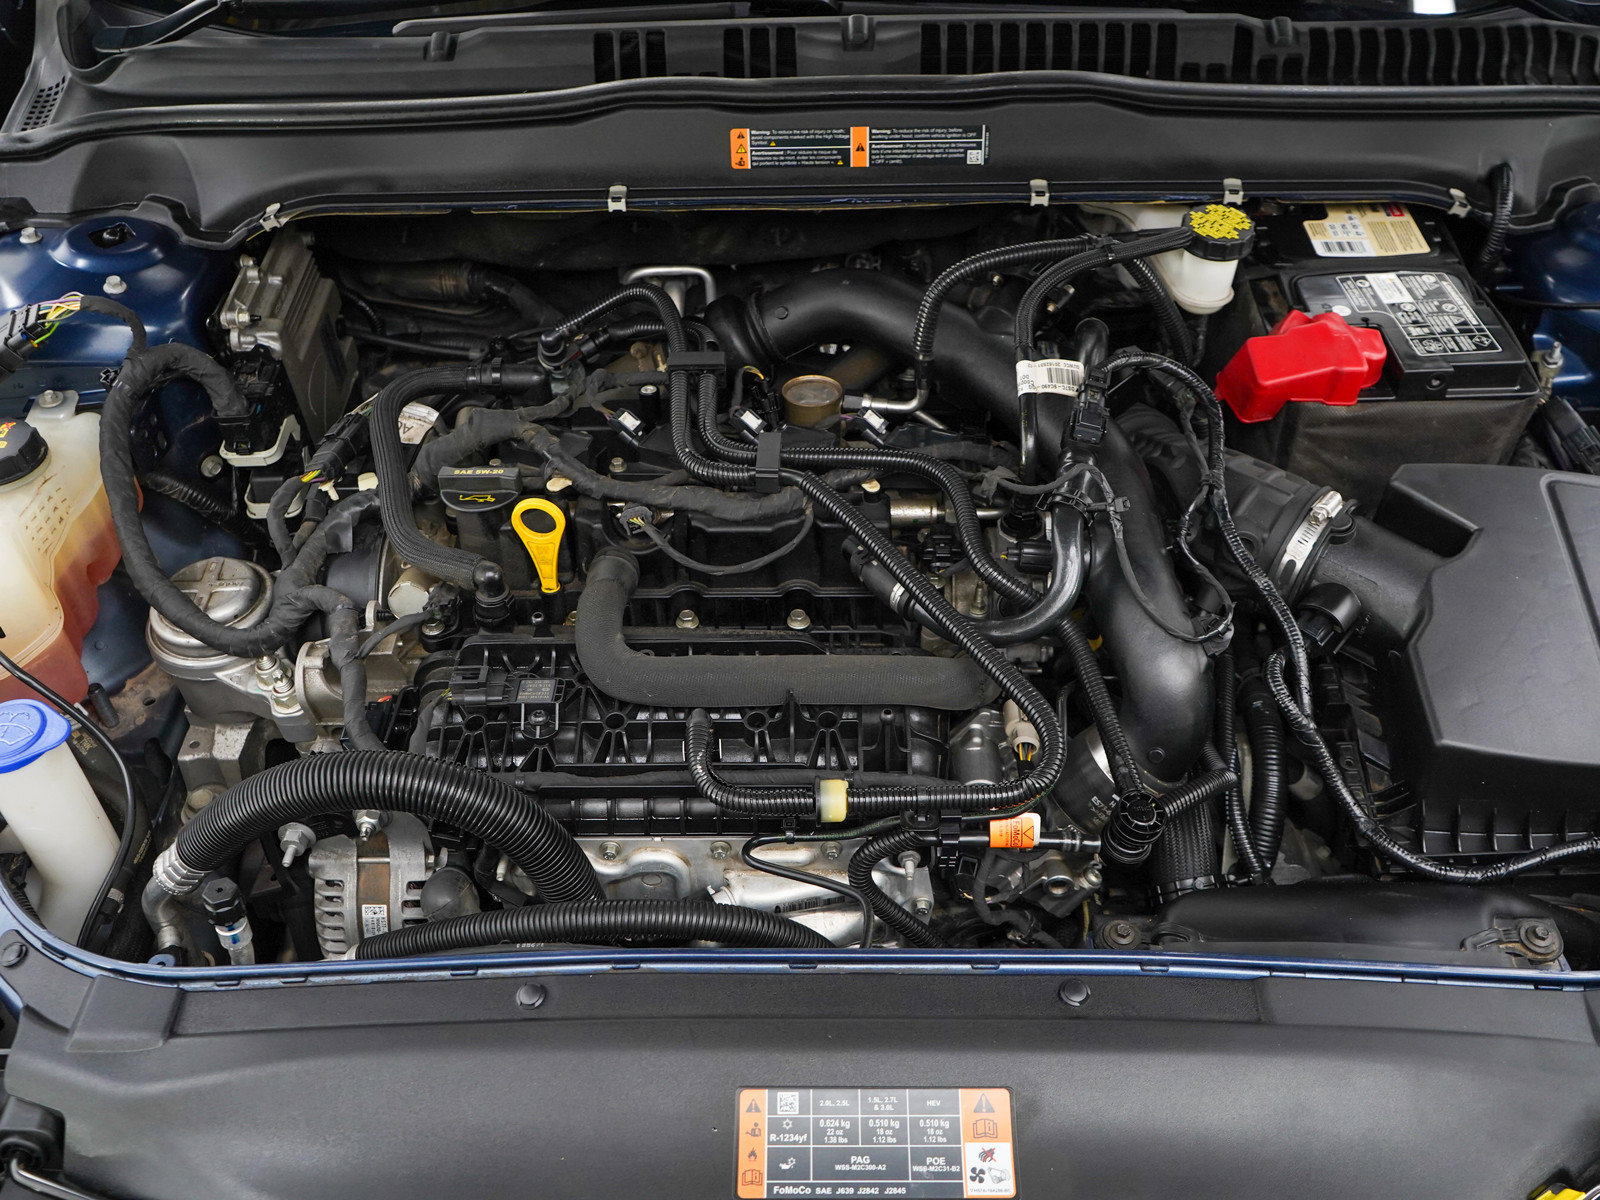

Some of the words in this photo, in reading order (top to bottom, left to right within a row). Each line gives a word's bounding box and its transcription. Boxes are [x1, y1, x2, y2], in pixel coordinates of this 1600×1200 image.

[819, 1119, 840, 1127] 0.624
[840, 1119, 851, 1129] kg
[868, 1119, 889, 1127] 0.510
[890, 1119, 900, 1129] kg
[919, 1119, 939, 1127] 0.510
[940, 1119, 950, 1129] kg
[769, 1133, 808, 1143] R-1234yf
[850, 1156, 870, 1164] PAG
[926, 1157, 946, 1165] POE
[773, 1186, 811, 1194] FoMoCo
